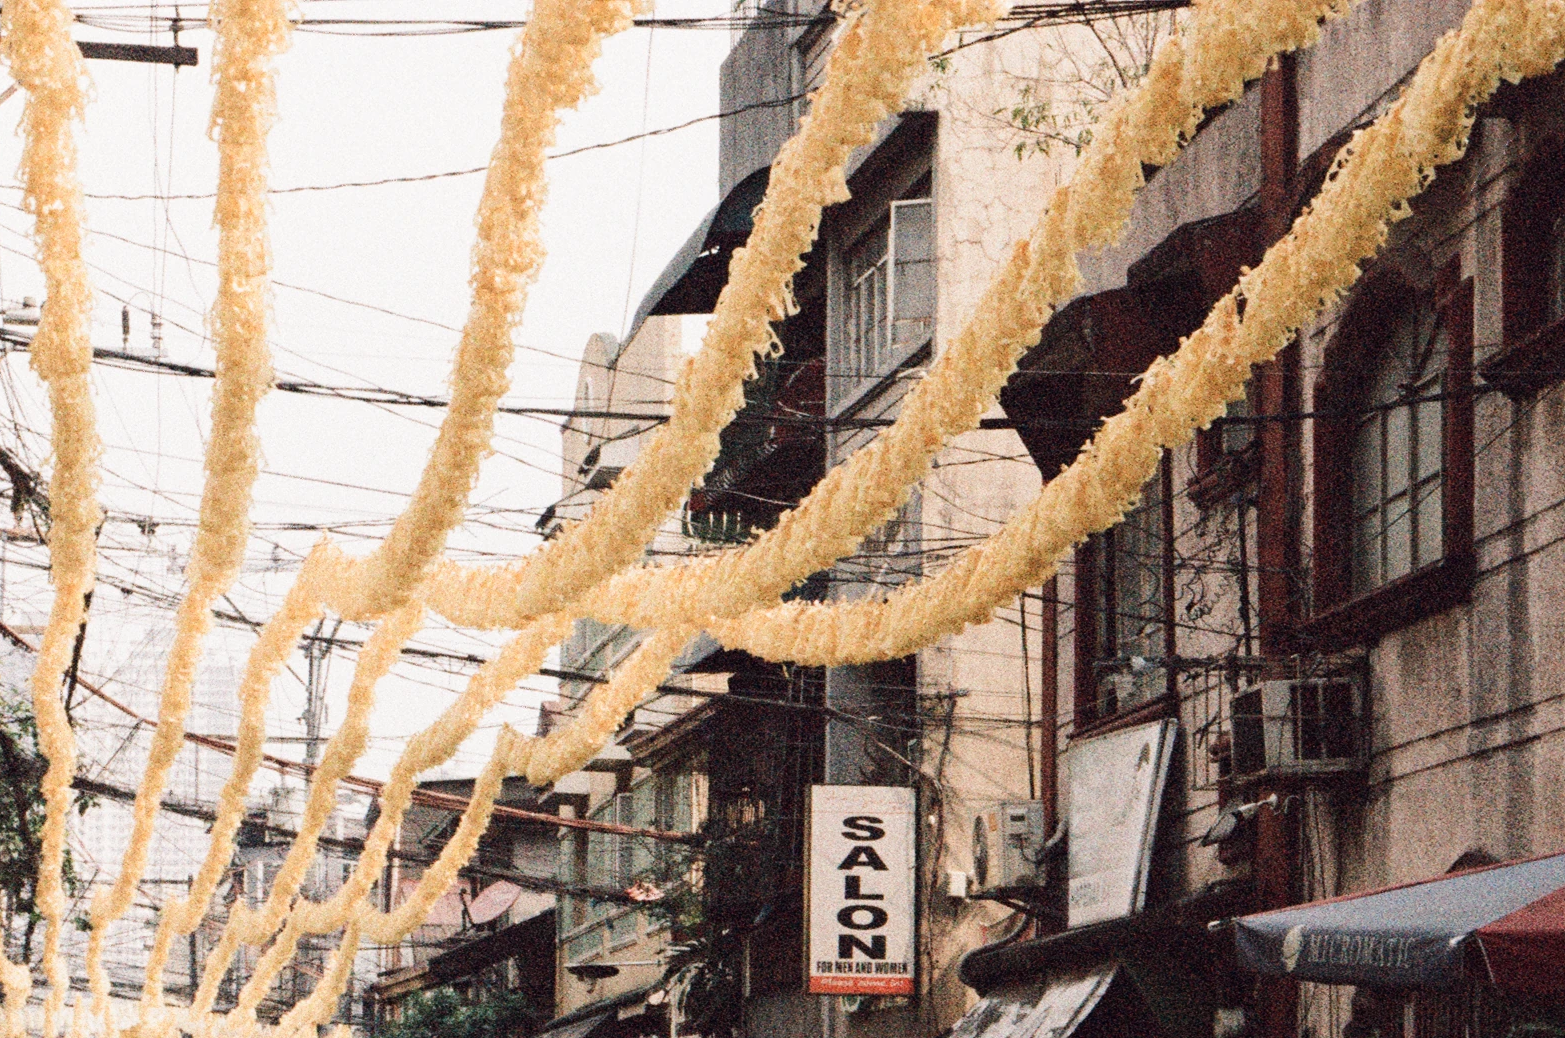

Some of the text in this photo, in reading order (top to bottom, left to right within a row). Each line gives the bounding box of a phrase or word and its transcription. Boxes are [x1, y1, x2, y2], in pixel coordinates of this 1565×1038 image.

[837, 815, 889, 960] SALON
[816, 961, 908, 974] FOR MEN AND WOMEN
